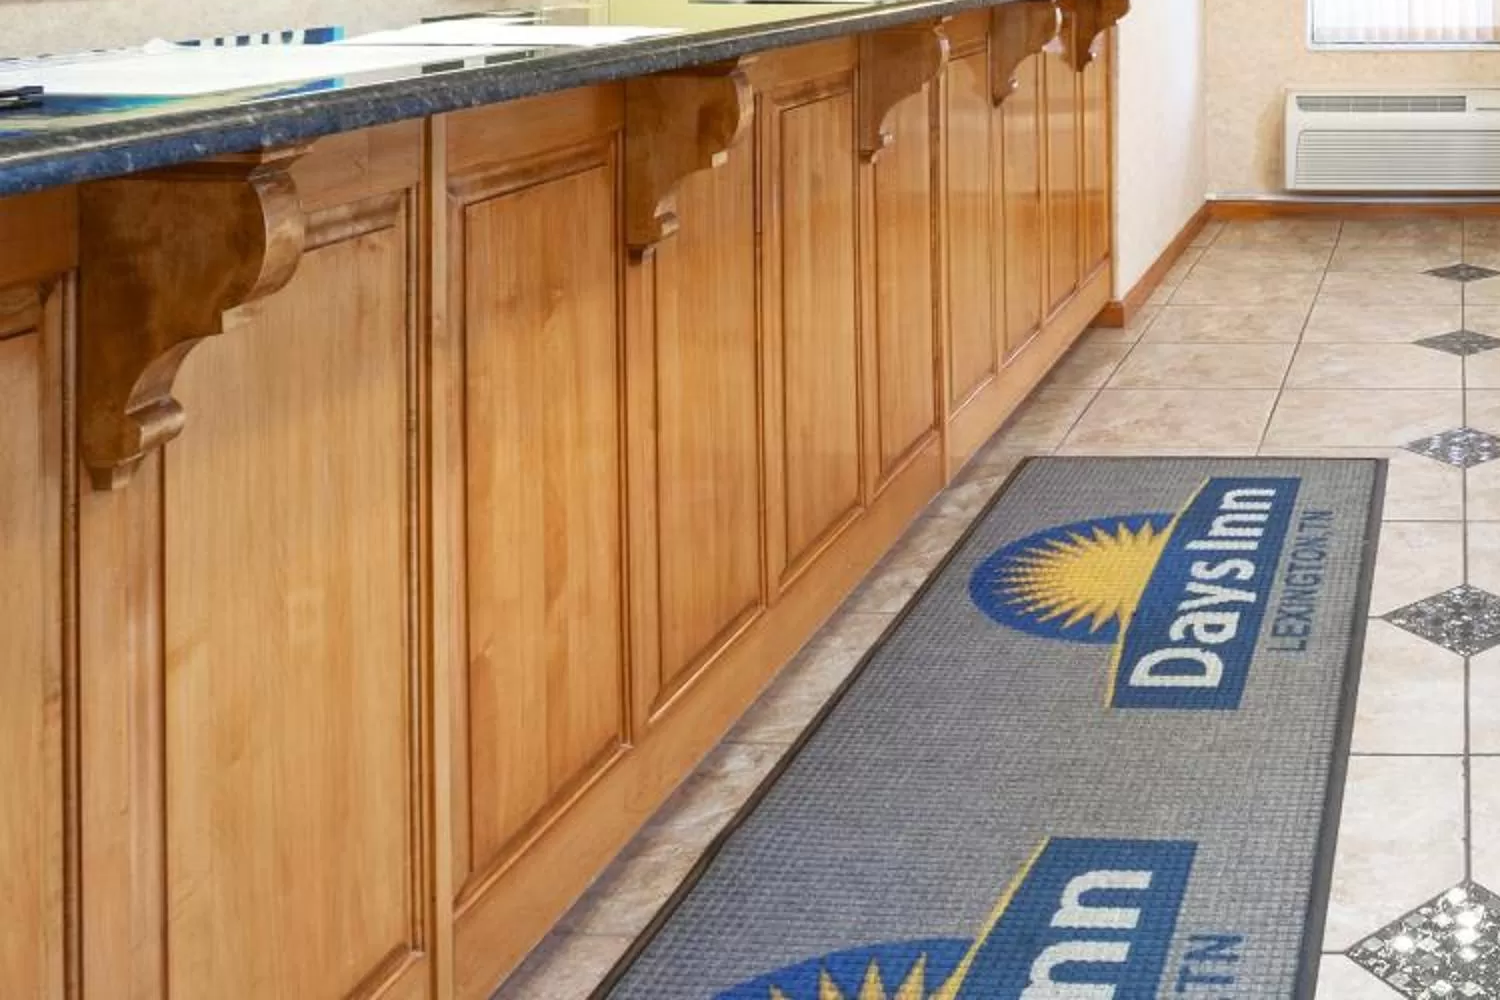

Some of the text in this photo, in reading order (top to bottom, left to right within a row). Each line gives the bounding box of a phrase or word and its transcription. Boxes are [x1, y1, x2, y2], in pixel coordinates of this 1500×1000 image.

[1129, 488, 1277, 688] Days Inn
[1018, 869, 1153, 1000] nn
